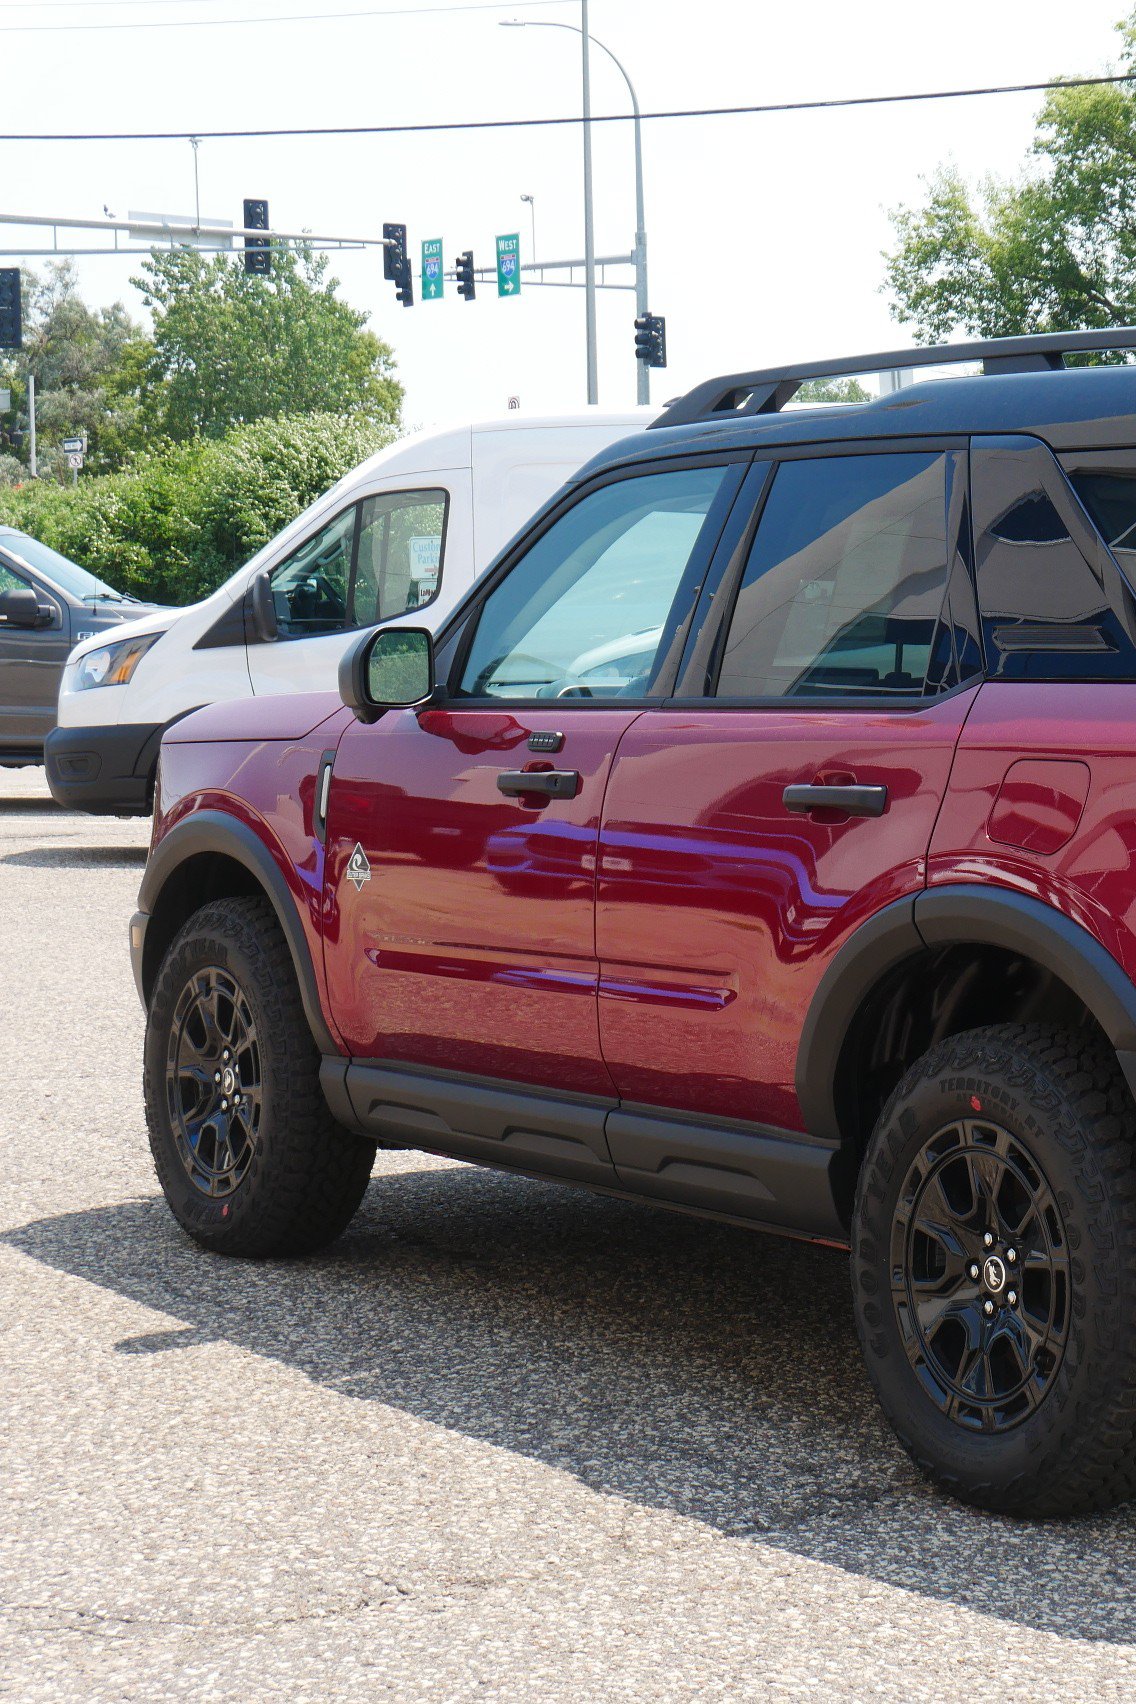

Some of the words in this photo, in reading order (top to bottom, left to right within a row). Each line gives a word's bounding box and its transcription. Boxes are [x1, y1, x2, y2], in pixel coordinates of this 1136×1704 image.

[424, 243, 440, 254] EAST
[499, 239, 517, 251] WEST
[426, 263, 439, 275] 694
[502, 260, 515, 274] 694
[939, 1077, 1020, 1113] TERRITORY
